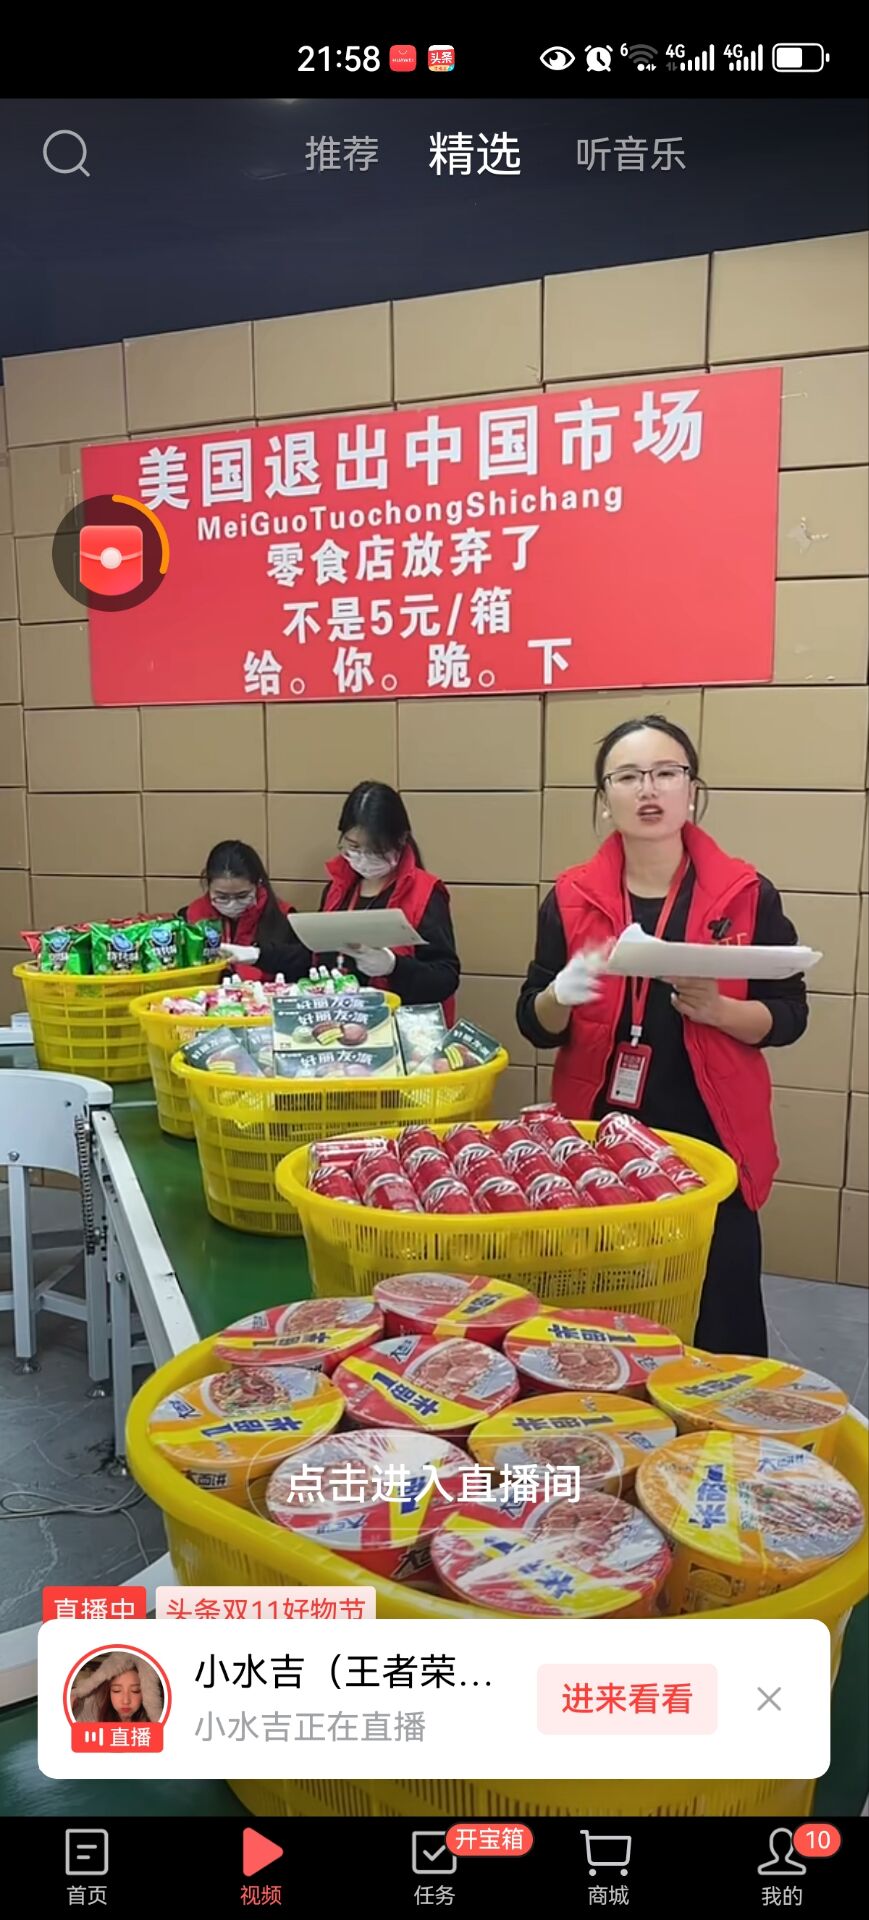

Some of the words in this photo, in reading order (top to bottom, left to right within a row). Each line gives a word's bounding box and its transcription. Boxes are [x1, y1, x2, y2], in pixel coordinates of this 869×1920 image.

[137, 389, 704, 512] 美国退出中国市场
[197, 485, 623, 541] MeiGuoTuochongShichang
[266, 524, 541, 588] 零食店放弃了
[282, 586, 513, 645] 不是5元/箱
